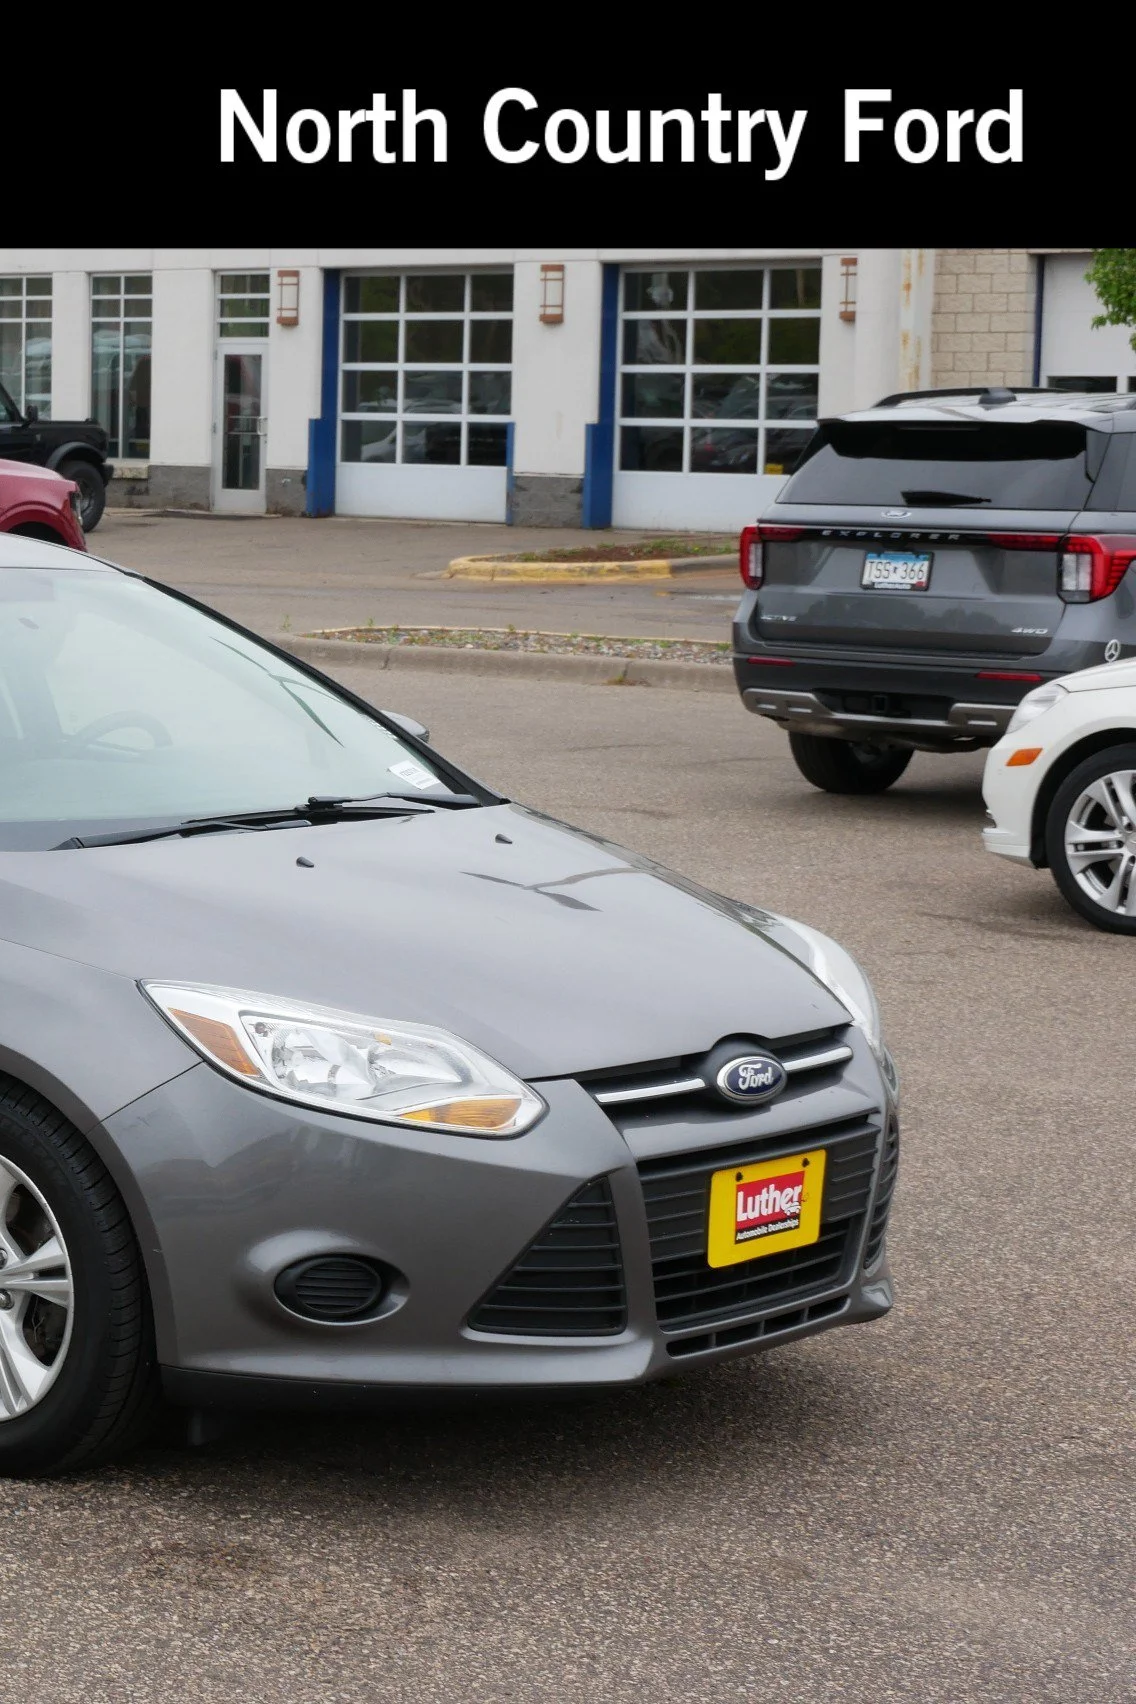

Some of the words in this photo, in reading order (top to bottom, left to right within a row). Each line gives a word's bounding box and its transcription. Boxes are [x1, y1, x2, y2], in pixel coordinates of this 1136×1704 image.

[821, 529, 961, 540] EXPLORER
[738, 1063, 774, 1090] Ford
[736, 1183, 803, 1222] Luther
